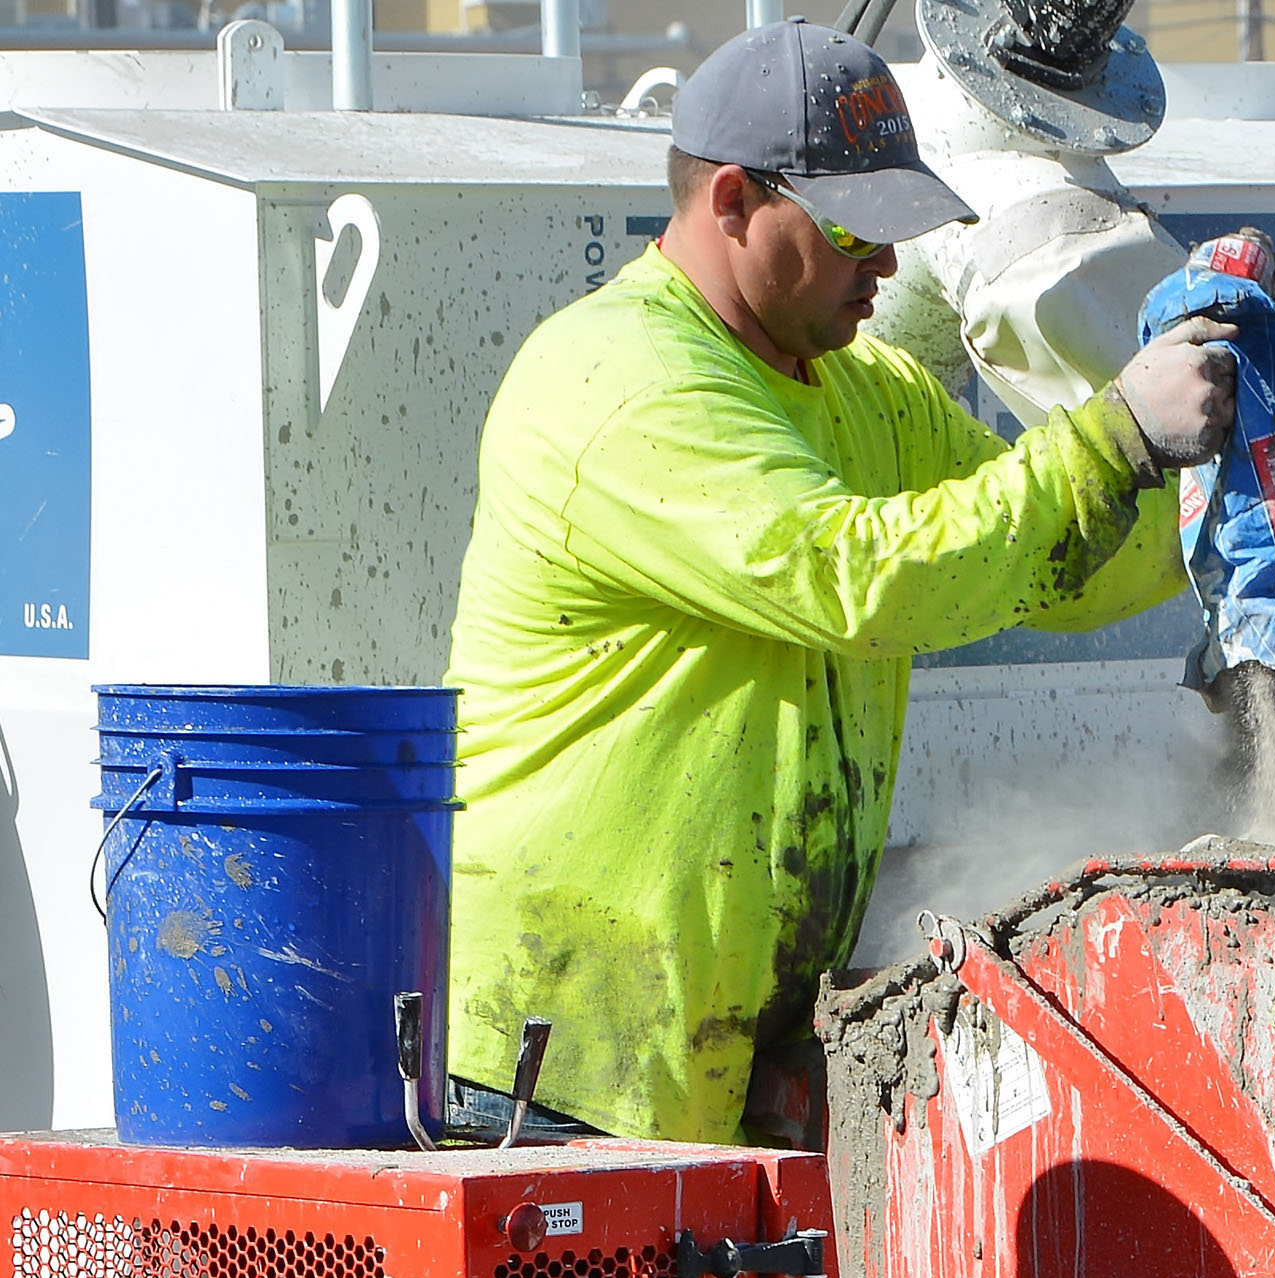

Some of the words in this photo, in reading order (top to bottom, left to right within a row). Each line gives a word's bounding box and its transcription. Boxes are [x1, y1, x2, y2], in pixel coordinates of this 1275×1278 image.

[877, 115, 911, 137] 2015
[24, 602, 75, 630] U.S.A.
[543, 1208, 571, 1218] PUSH
[551, 1218, 579, 1229] STOP
